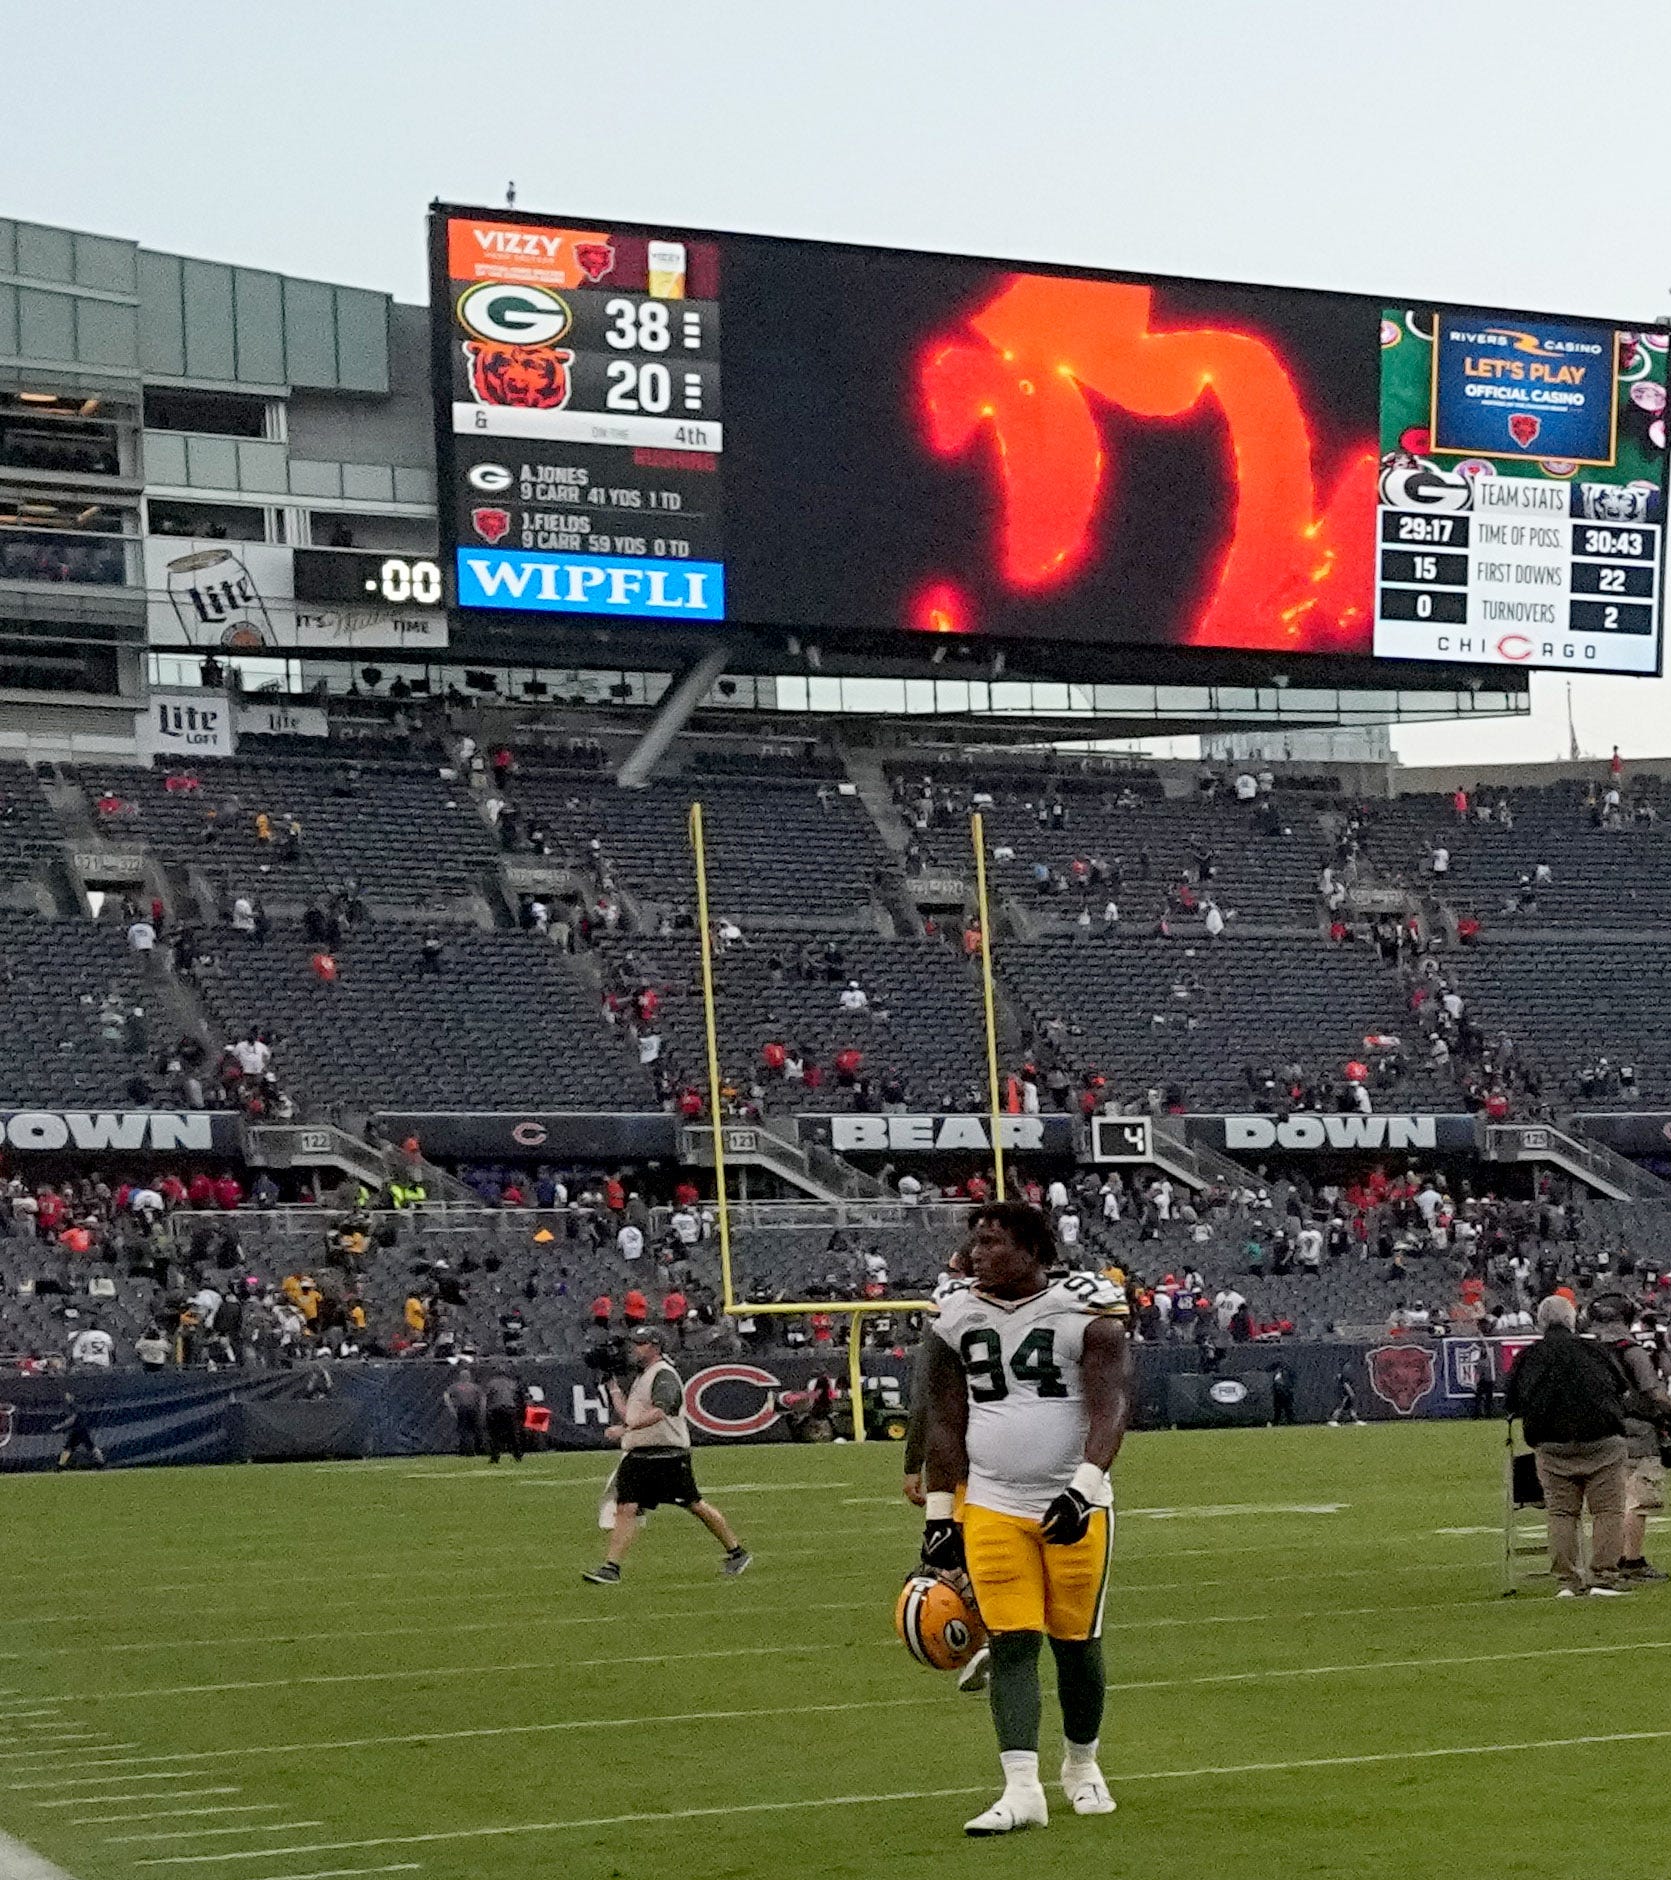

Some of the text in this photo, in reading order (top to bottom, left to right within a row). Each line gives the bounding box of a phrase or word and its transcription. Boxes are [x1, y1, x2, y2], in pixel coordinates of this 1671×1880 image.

[473, 229, 562, 256] VIZZY
[605, 299, 671, 352] 38
[1450, 330, 1602, 355] RIVERS CASINO
[1464, 357, 1585, 385] LET'S PLAY
[606, 360, 671, 413] 20
[1465, 384, 1528, 402] OFFICIAL
[1530, 391, 1585, 406] CASINO
[475, 411, 488, 429] &
[674, 427, 708, 446] 4th
[519, 464, 589, 486] A.JONES
[520, 482, 682, 510] 9 CARR 41 YDS 1 TD
[1480, 483, 1564, 511] TEAM STATS
[522, 513, 591, 534] J.FIELDS
[1400, 517, 1453, 542] 29:17
[1479, 523, 1563, 549] TIME OF POSS.
[522, 532, 689, 558] 9 CARR 59 YDS 0 TD
[1585, 531, 1643, 555] 30:43
[1413, 557, 1437, 580] 15
[1478, 561, 1562, 587] FIRST DOWNS
[1600, 569, 1626, 592] 22
[467, 559, 708, 609] WIPFLI
[187, 576, 259, 622] Lite
[1416, 595, 1433, 618] 0
[1483, 600, 1555, 624] TURNOVERS
[1604, 606, 1619, 629] 2
[392, 619, 430, 635] TIME
[159, 704, 218, 738] Lite
[0, 1114, 213, 1150] OWN
[303, 1133, 328, 1148] 122
[732, 1134, 754, 1148] 123
[831, 1118, 1044, 1149] BEAR
[1124, 1127, 1145, 1152] 4
[1225, 1116, 1437, 1149] DOWN
[960, 1327, 1069, 1403] 94
